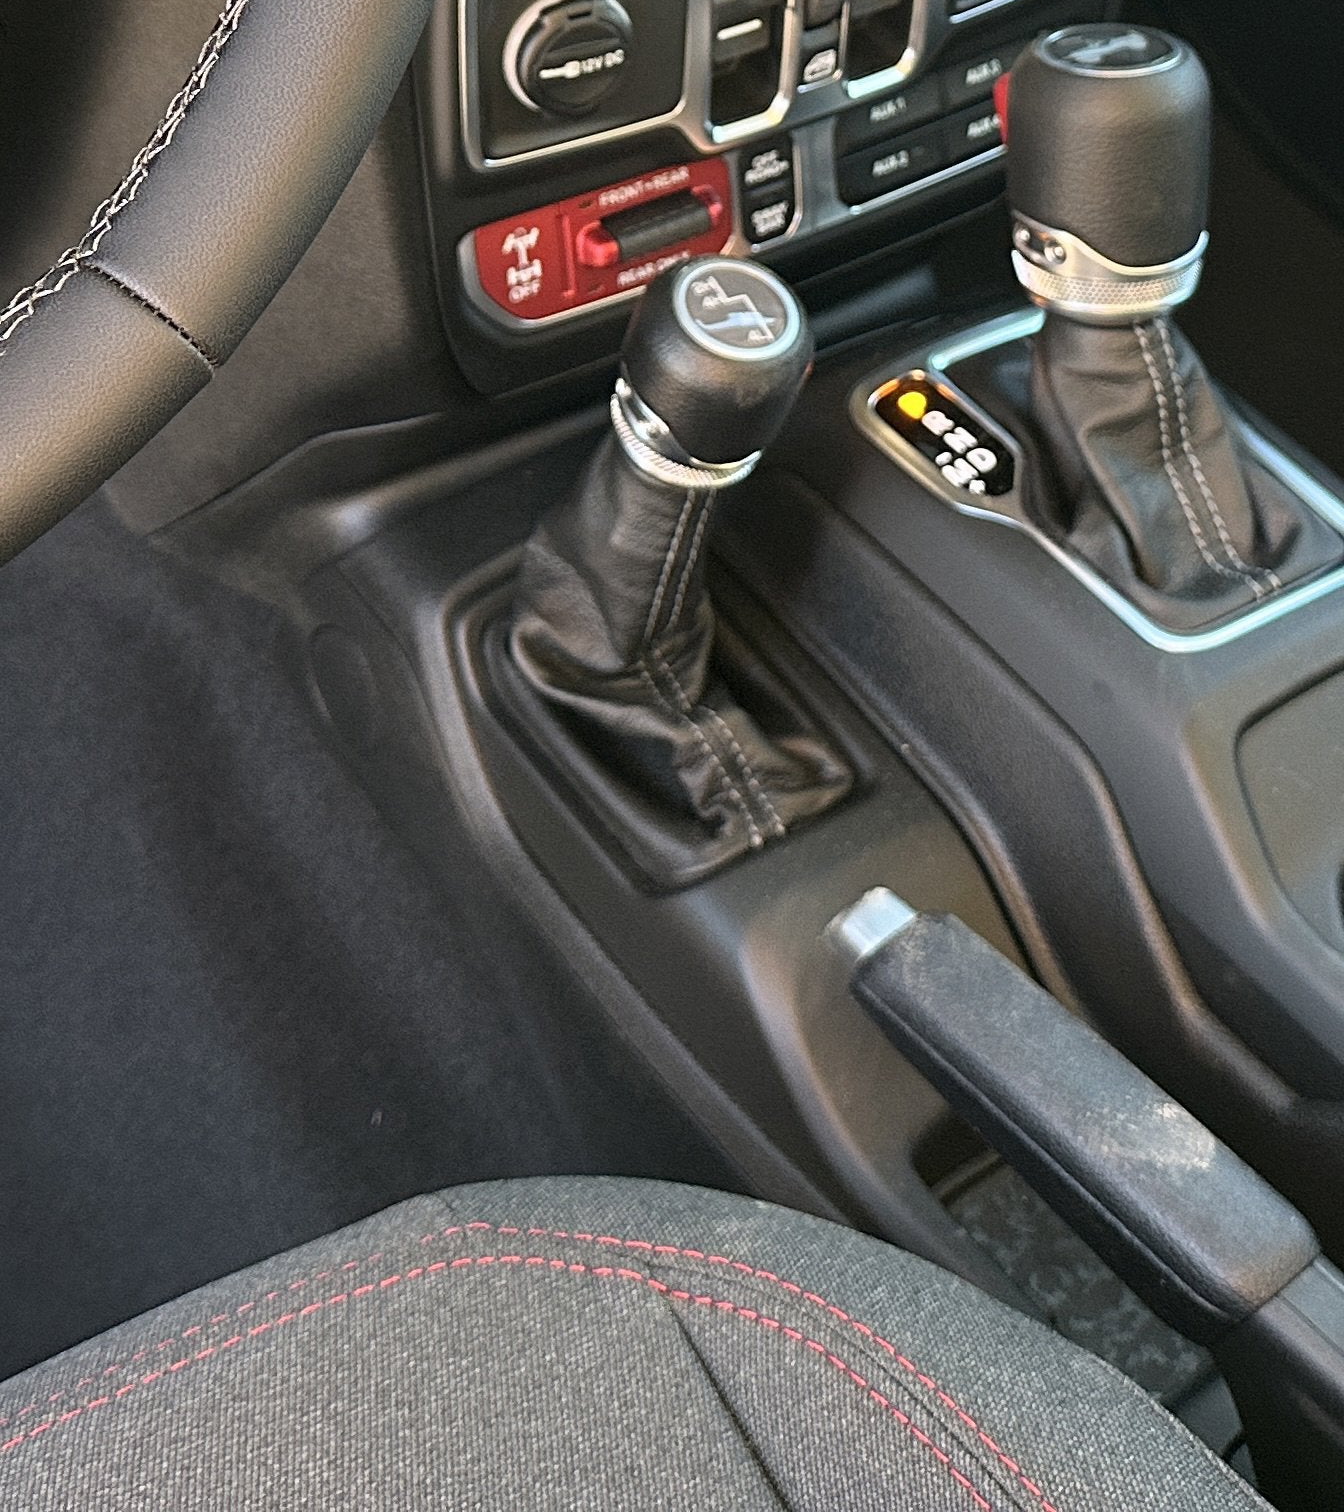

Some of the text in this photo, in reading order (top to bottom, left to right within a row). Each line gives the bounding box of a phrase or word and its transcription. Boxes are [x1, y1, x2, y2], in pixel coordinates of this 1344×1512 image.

[617, 262, 654, 288] REAR
[508, 281, 540, 303] OFF
[922, 410, 997, 473] R N D
